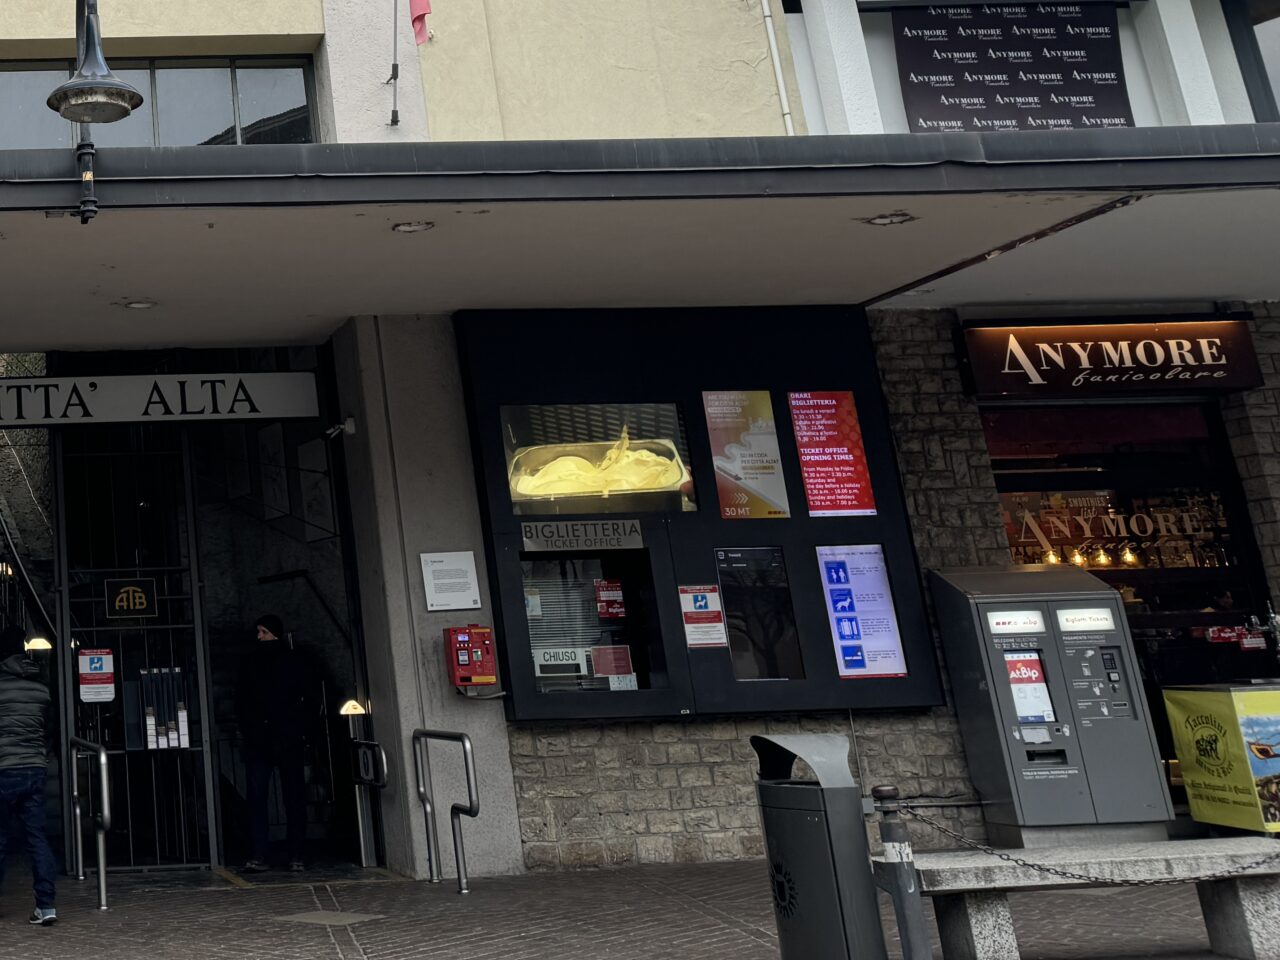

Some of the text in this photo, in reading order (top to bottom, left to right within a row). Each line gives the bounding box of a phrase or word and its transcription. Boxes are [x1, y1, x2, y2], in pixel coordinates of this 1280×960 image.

[903, 26, 948, 37] ANYMORE
[957, 25, 1003, 37] ANYMORE
[1012, 24, 1056, 36] ANYMORE
[1065, 24, 1111, 35] ANYMORE
[932, 48, 978, 60] ANYMORE
[987, 48, 1033, 59] ANYMORE
[1042, 47, 1087, 58] ANYMORE
[909, 72, 954, 83] ANYMORE
[963, 71, 1009, 82] ANYMORE
[1018, 70, 1063, 81] ANYMORE
[1072, 70, 1118, 81] ANYMORE
[940, 94, 985, 105] ANYMORE
[995, 93, 1040, 104] ANYMORE
[1050, 92, 1095, 104] ANYMORE
[917, 117, 964, 128] ANYMORE
[972, 116, 1018, 127] ANYMORE
[1027, 116, 1073, 126] ANYMORE
[1081, 115, 1127, 125] ANYMORE
[1000, 333, 1227, 385] ANYMORE
[1072, 366, 1228, 387] funicolare
[141, 377, 262, 417] ALTA
[1068, 496, 1106, 508] SMOOTHIES
[724, 507, 751, 516] 30 MT
[524, 522, 641, 539] BIGLIETTERIA
[1018, 508, 1206, 552] ANYMORE
[544, 537, 623, 549] TICKET OFFICE
[115, 585, 148, 610] ATB
[542, 650, 577, 663] CHIUSO
[1184, 713, 1228, 739] Taccolini
